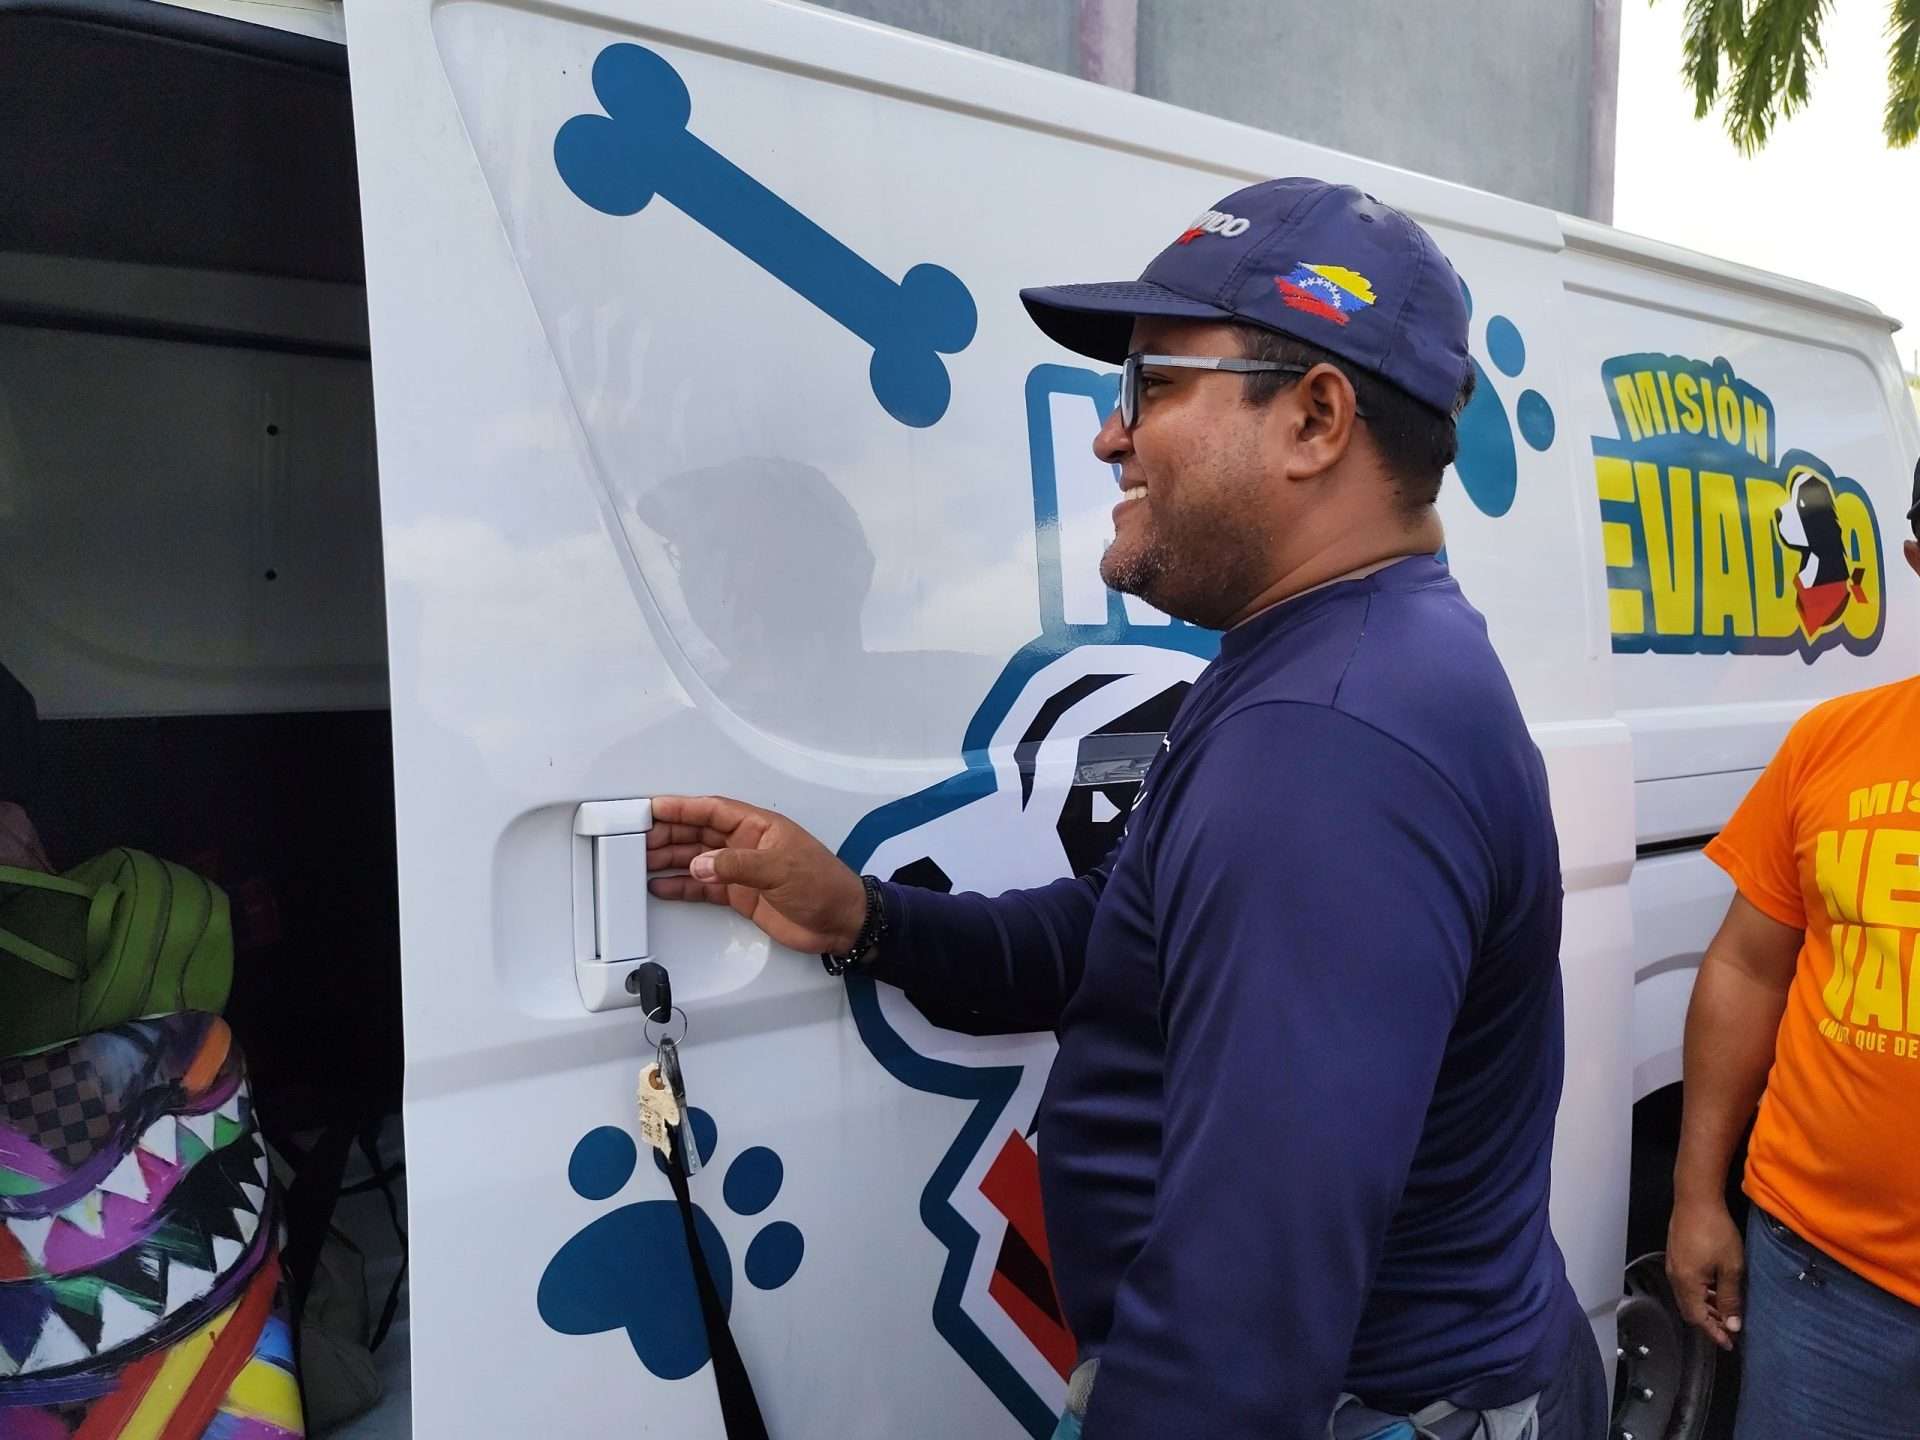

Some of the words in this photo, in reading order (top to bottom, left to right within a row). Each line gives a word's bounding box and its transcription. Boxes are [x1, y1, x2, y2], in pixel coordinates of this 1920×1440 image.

[1613, 370, 1768, 464] MISIÓN
[1822, 923, 1920, 1036] VA
[1855, 1029, 1887, 1053] QUE
[1894, 1036, 1920, 1059] DE
